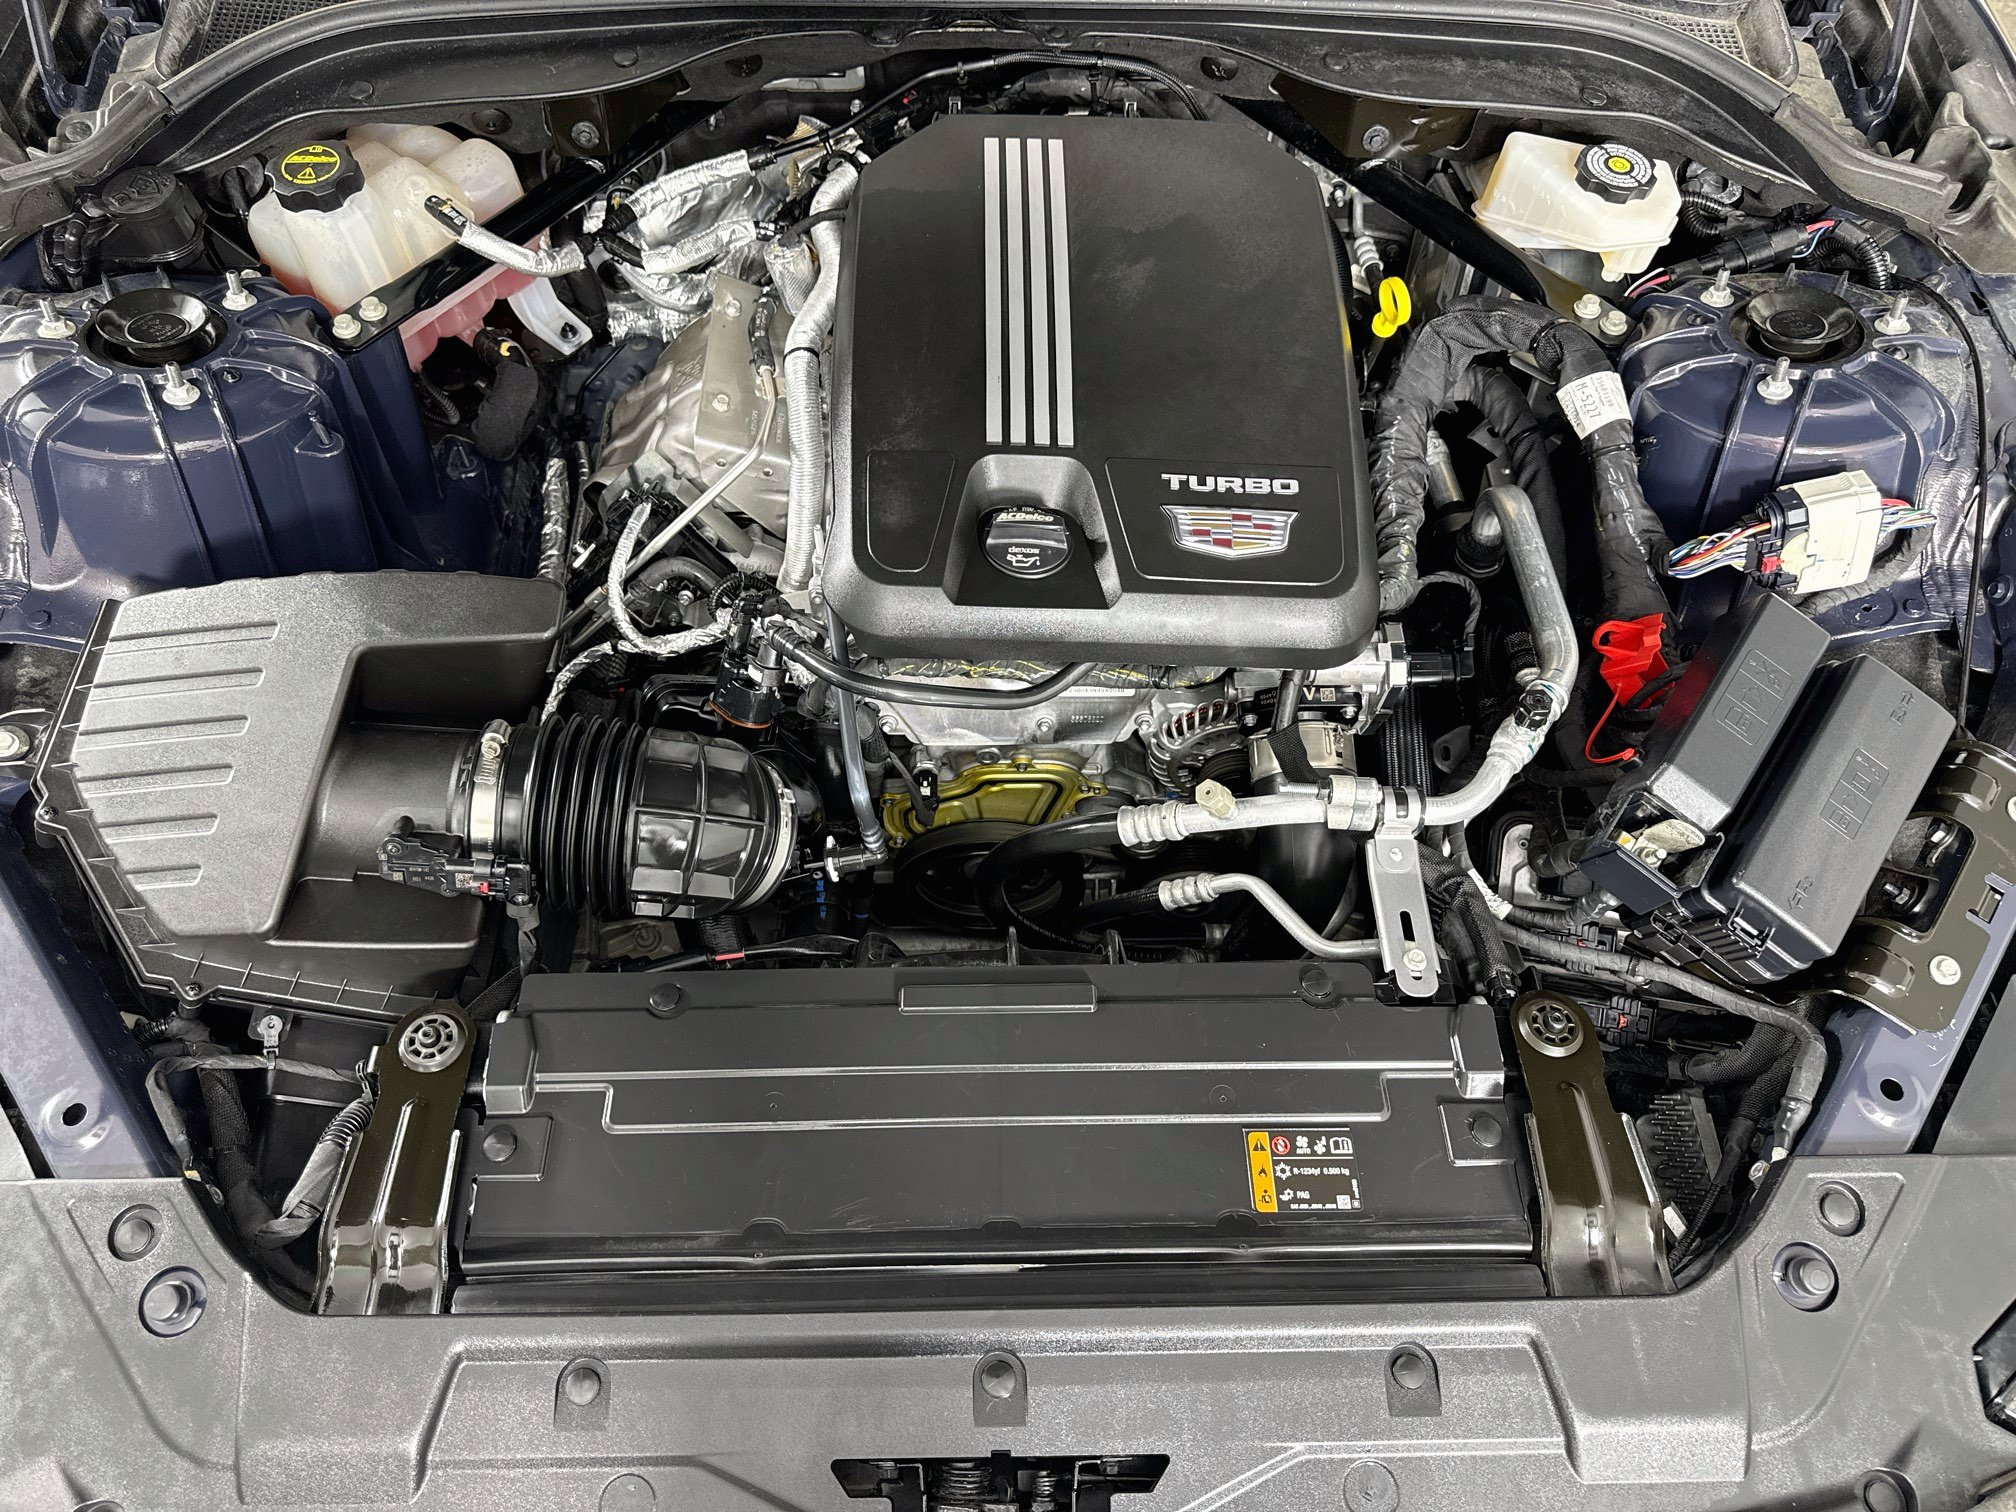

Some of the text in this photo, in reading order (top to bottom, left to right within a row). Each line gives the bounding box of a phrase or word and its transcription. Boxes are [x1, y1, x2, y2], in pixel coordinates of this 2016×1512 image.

[1575, 382, 1602, 418] M-5227
[1161, 473, 1300, 495] TURBO
[995, 512, 1055, 523] ACDelco
[1008, 546, 1040, 554] dexos
[1302, 687, 1316, 701] V
[1296, 1147, 1311, 1155] AUTO
[1292, 1167, 1350, 1176] R-1234yf 0.500 kg
[1296, 1190, 1310, 1199] PAG
